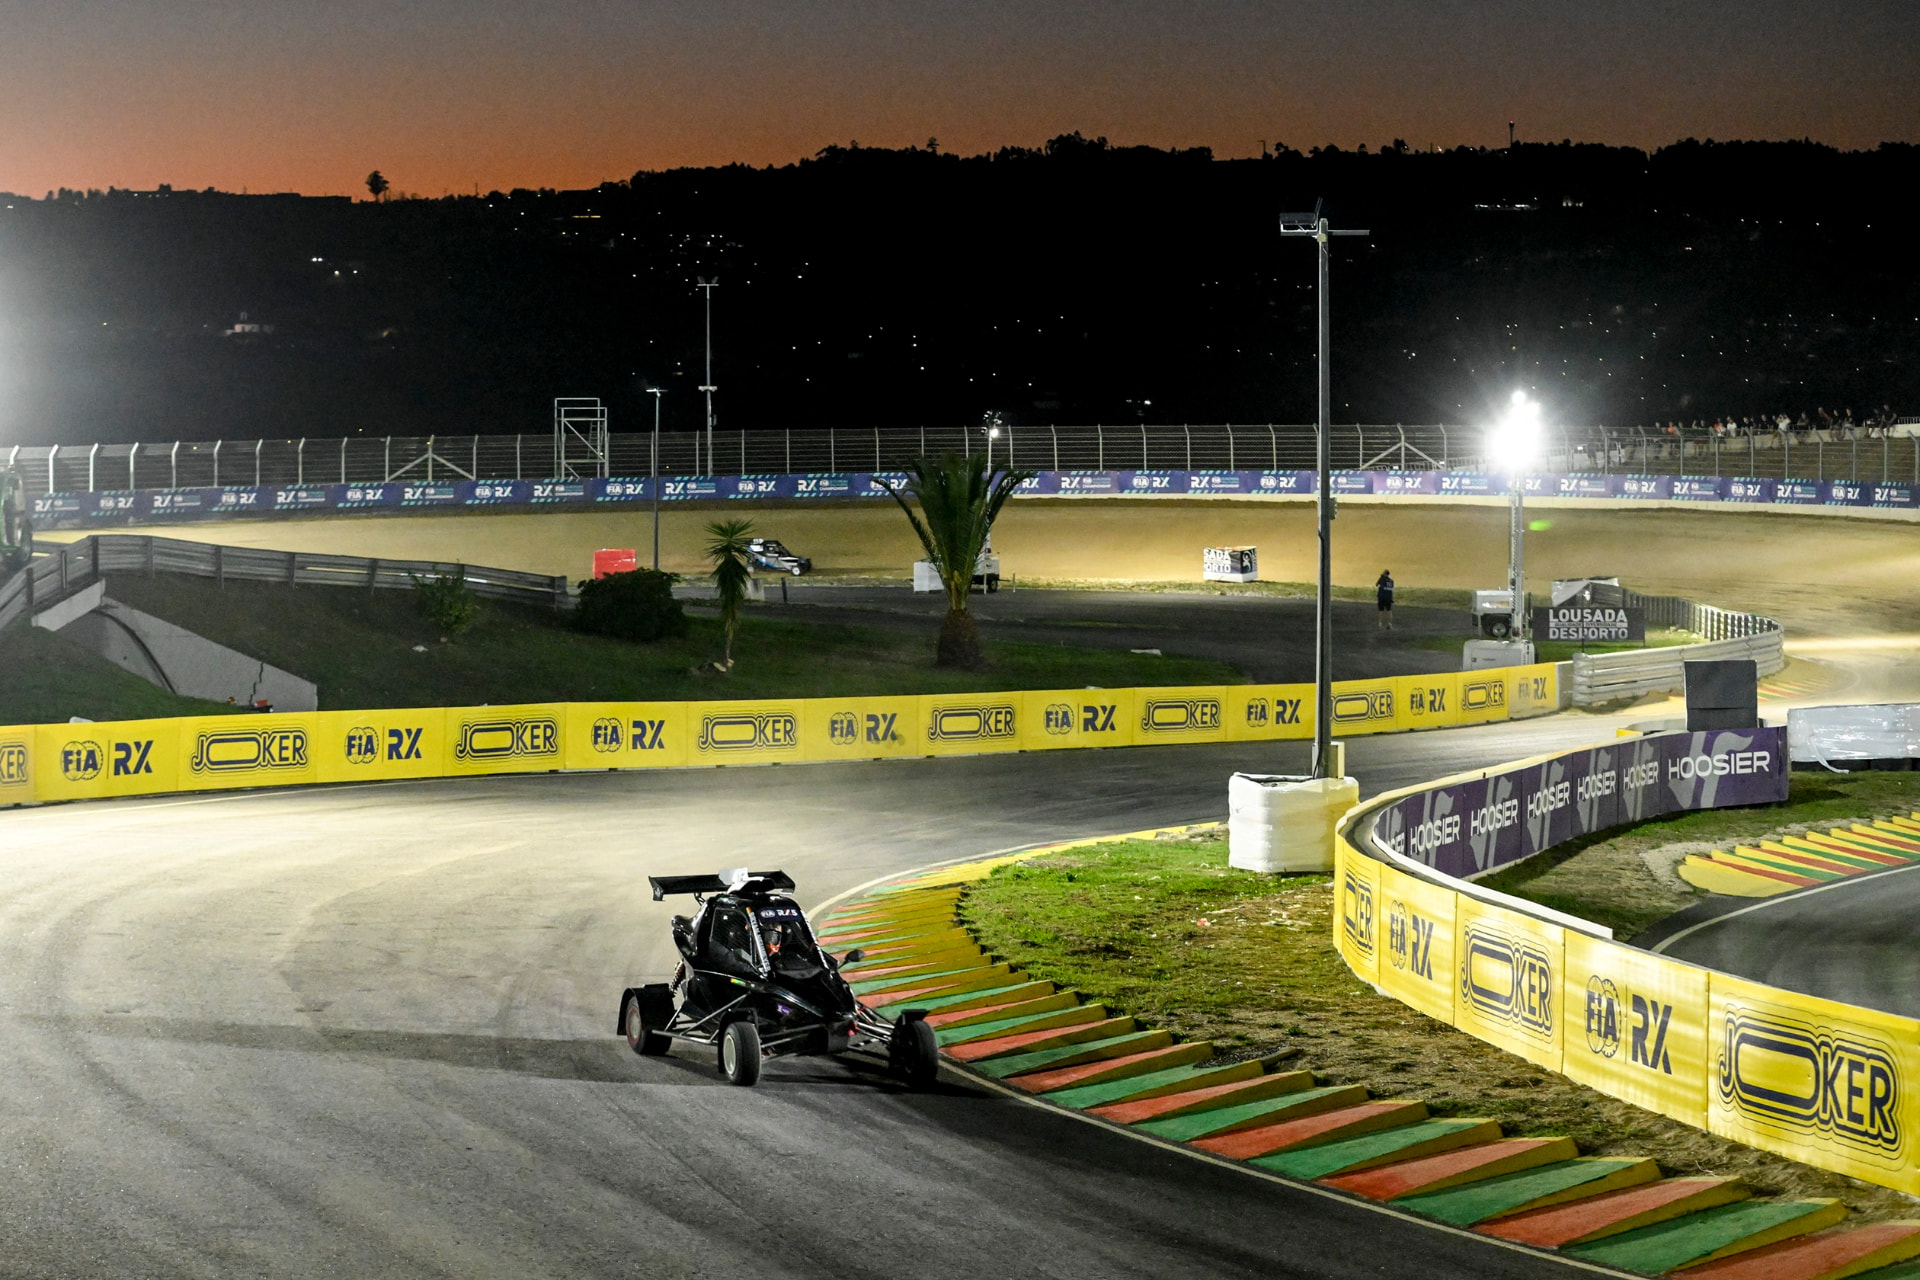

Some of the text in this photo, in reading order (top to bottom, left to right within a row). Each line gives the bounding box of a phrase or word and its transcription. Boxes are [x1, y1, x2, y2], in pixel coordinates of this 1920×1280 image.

[665, 482, 684, 494] RX
[758, 480, 776, 492] RX
[798, 480, 817, 491] RX
[1022, 477, 1039, 488] RX
[1061, 477, 1080, 488] RX
[1133, 477, 1170, 488] FIA RX
[1191, 476, 1209, 488] RX
[1260, 476, 1297, 488] FIA RX
[1387, 477, 1422, 488] FIA RX
[1442, 478, 1459, 489] RX
[1526, 479, 1541, 490] RX
[1561, 479, 1577, 491] RX
[1624, 481, 1656, 493] FIA RX
[1674, 482, 1689, 494] RX
[366, 489, 383, 500] RX
[404, 487, 423, 500] RX
[495, 486, 512, 497] RX
[534, 485, 553, 497] RX
[626, 483, 643, 495] RX
[1731, 485, 1761, 496] FIA RX
[1777, 485, 1792, 497] RX
[1832, 487, 1860, 499] FIA RX
[1874, 488, 1889, 501] RX
[118, 497, 134, 508] RX
[153, 495, 171, 507] RX
[240, 492, 257, 504] RX
[277, 491, 296, 503] RX
[1549, 609, 1627, 622] LOUSADA
[1549, 628, 1628, 640] DESPORTO
[1534, 677, 1547, 700] RX
[1429, 688, 1446, 712] RX
[1463, 682, 1504, 709] JOKER
[1275, 699, 1301, 725] RX
[1332, 691, 1394, 721] OKER
[1084, 705, 1116, 732] RX
[1143, 699, 1220, 729] JOKER
[866, 713, 898, 741] RX
[929, 706, 1014, 738] JOKER
[457, 718, 558, 757] JOKER
[632, 720, 665, 750] RX
[700, 713, 796, 750] JOKER
[193, 731, 307, 770] JOKER
[388, 728, 423, 760] RX
[113, 740, 154, 776] RX
[1669, 751, 1770, 780] HOOSIER
[1623, 761, 1659, 791] HOOSIER
[1577, 770, 1616, 802] HOOSIER
[1528, 781, 1570, 819] HOOSIER
[1471, 798, 1519, 837] HOOSIER
[1410, 814, 1461, 855] HOOSIER
[1411, 914, 1434, 981] RX
[1462, 930, 1551, 1031] JOKER
[1631, 993, 1673, 1075] RX
[1719, 1014, 1897, 1146] JOKER
